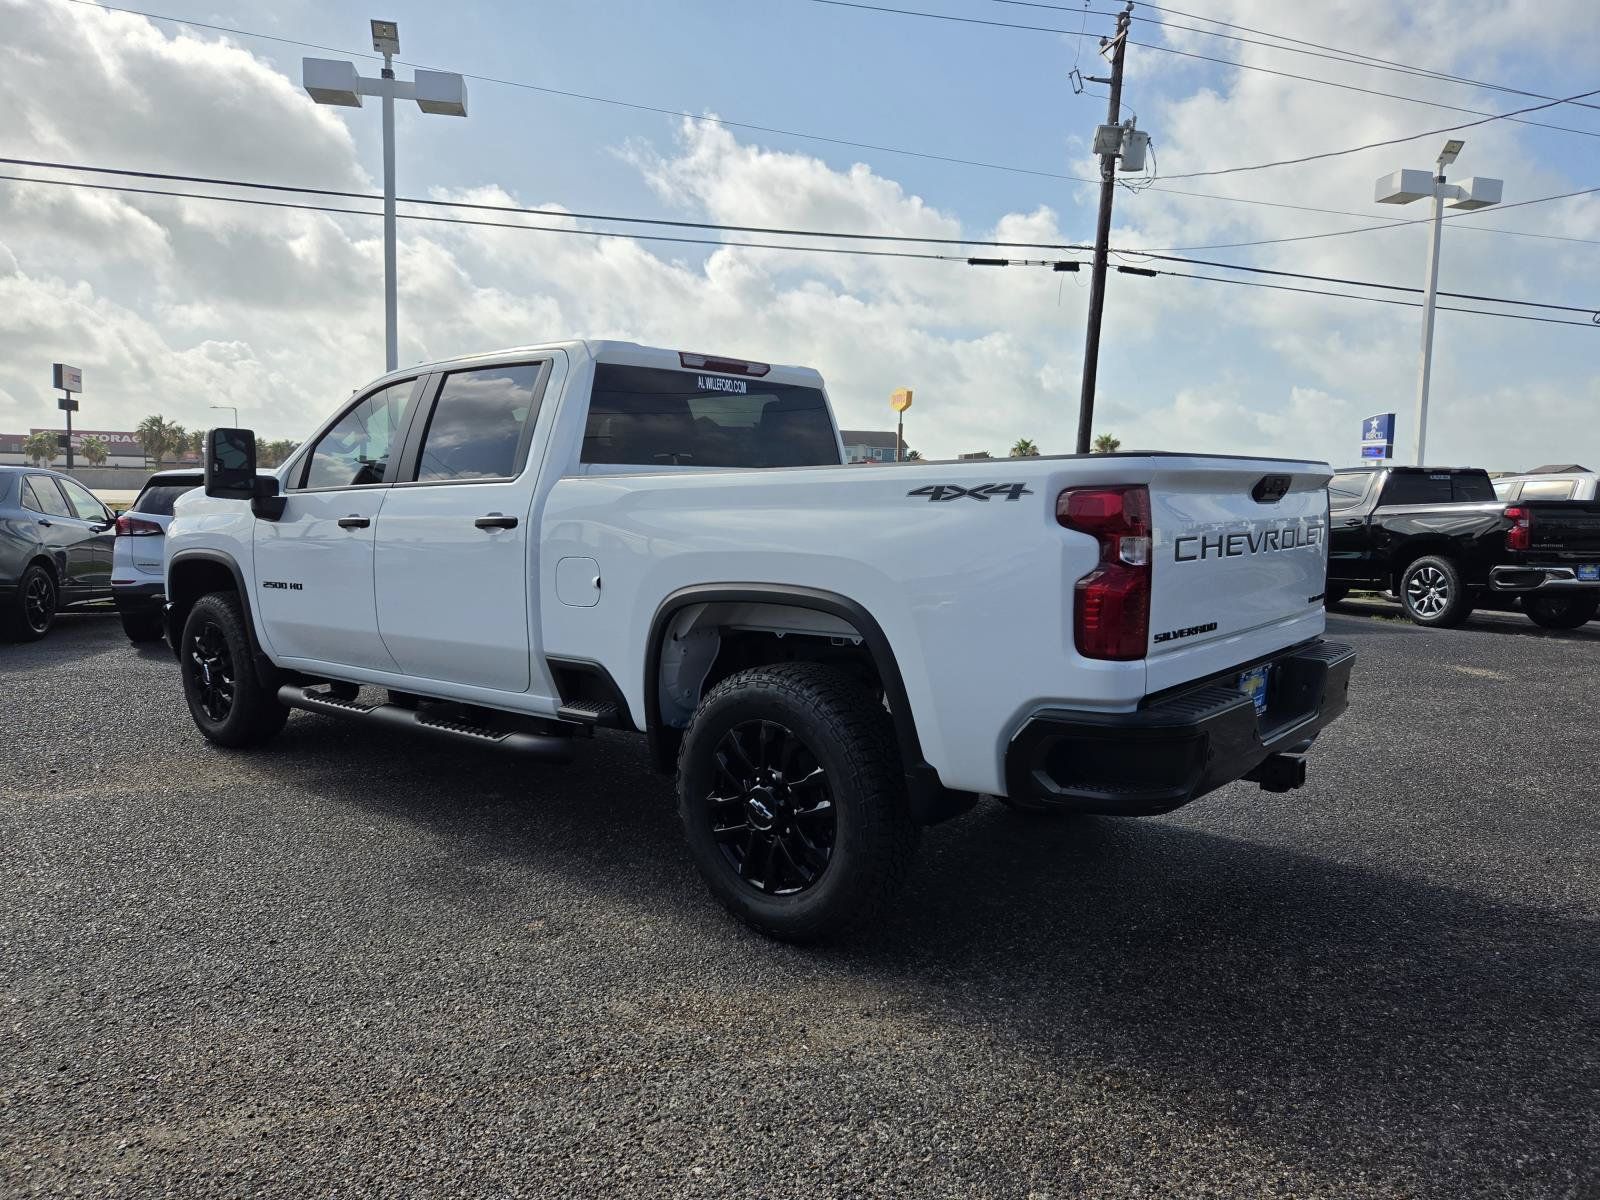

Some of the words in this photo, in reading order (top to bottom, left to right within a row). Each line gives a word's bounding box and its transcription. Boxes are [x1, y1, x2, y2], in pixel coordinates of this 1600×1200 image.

[706, 377, 747, 394] WILLEFORD.COM
[79, 433, 142, 443] STORAG
[1174, 526, 1324, 563] CHEVROLET
[262, 581, 287, 590] 2500
[289, 582, 303, 591] HD
[1153, 622, 1218, 644] SILVERADO
